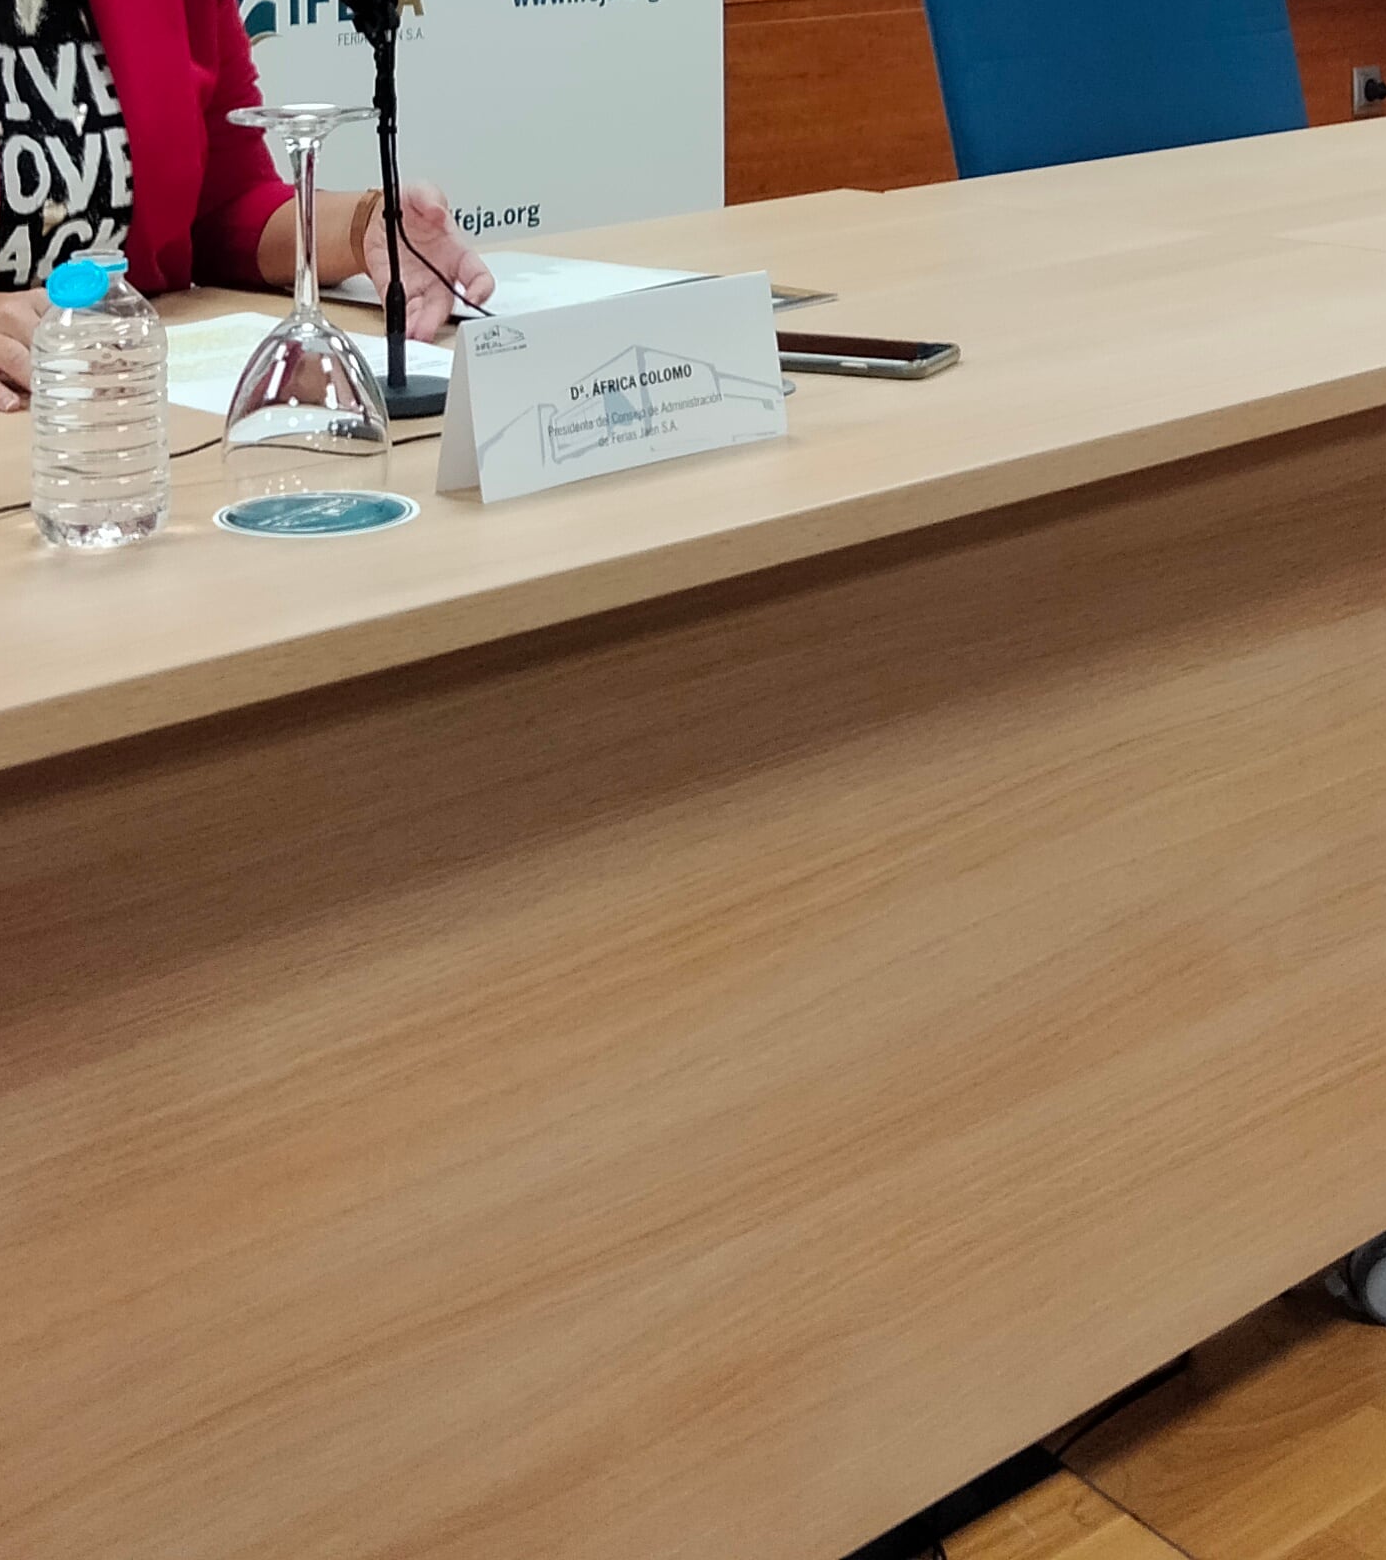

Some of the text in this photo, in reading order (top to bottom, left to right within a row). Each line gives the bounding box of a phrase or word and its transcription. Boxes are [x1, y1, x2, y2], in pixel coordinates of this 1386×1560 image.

[450, 203, 541, 236] feja.org
[592, 375, 637, 397] ÁFRICA
[639, 364, 692, 386] COLOMO
[548, 419, 594, 437] Presidenta
